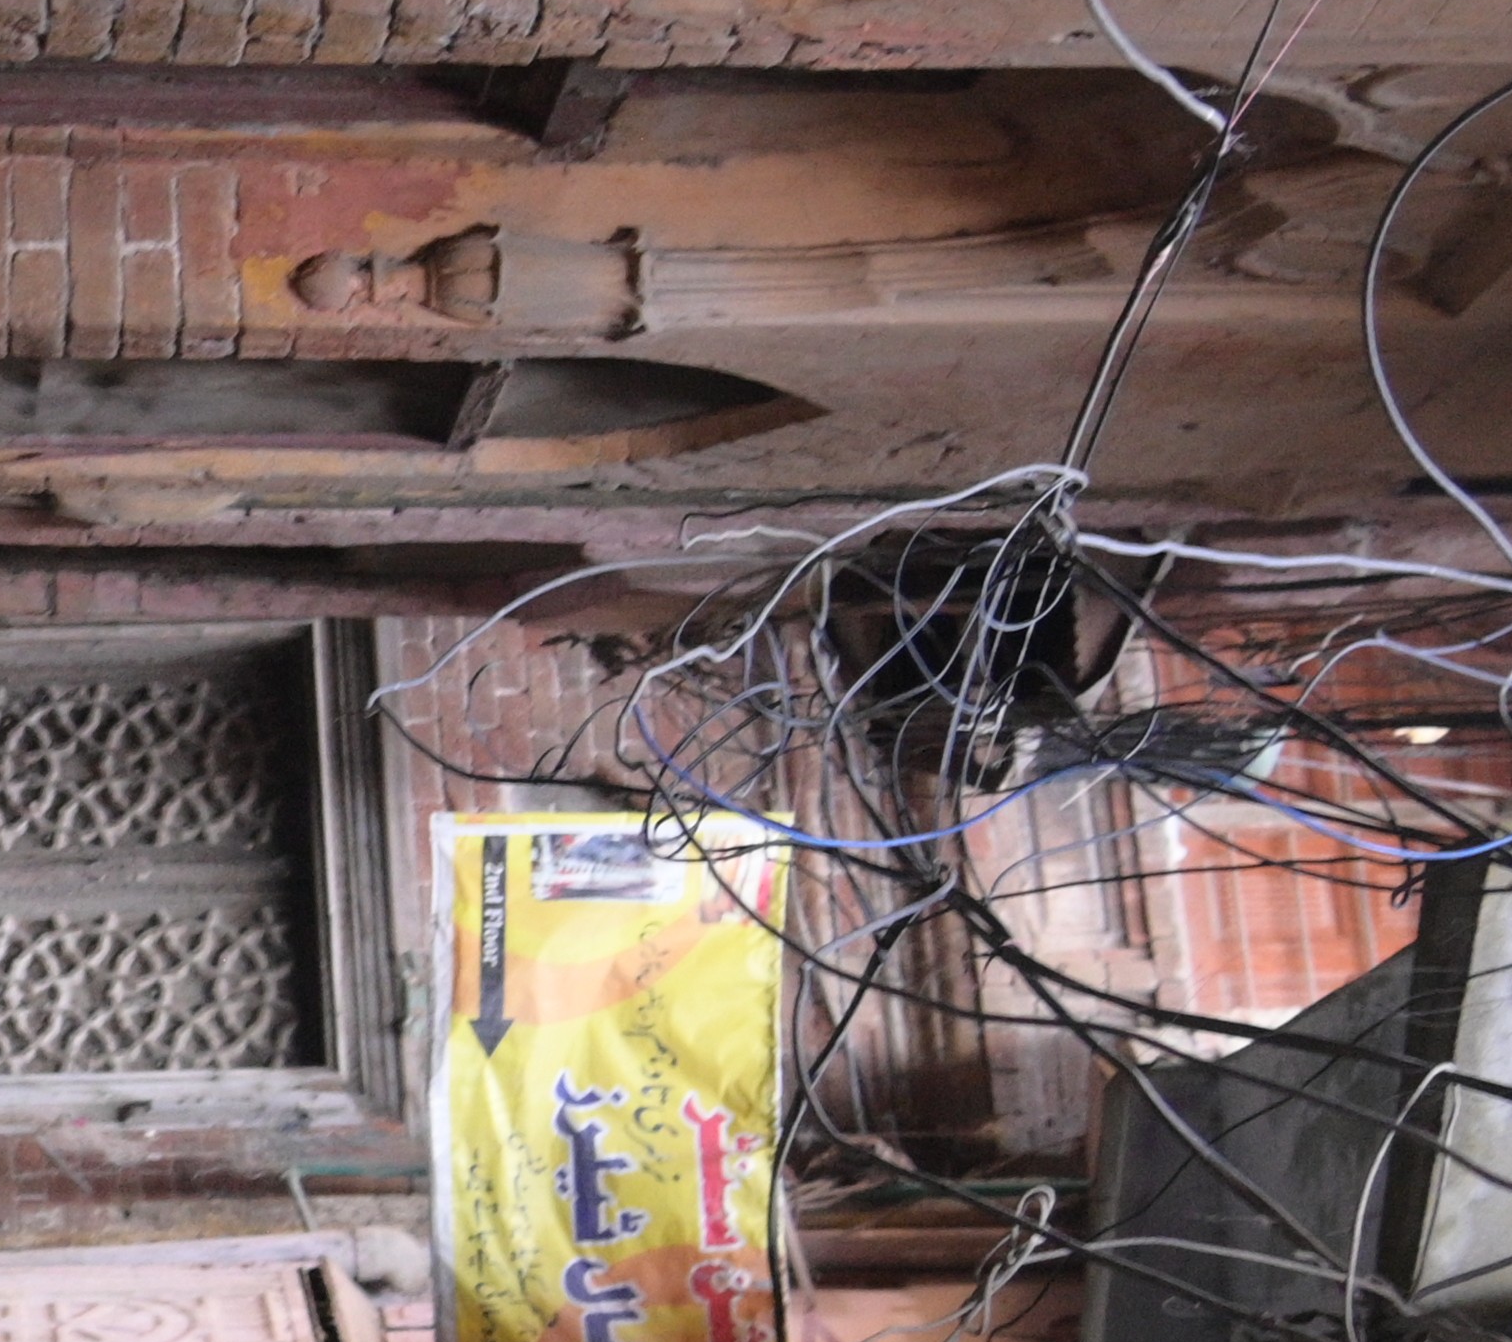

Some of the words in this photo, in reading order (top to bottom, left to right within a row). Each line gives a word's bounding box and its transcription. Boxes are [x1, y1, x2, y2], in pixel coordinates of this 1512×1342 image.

[484, 861, 505, 904] 2nd
[483, 908, 505, 968] Floor
[621, 1032, 680, 1079] دہم
[640, 1084, 674, 1106] تا
[554, 1070, 649, 1245] ٹیلرز
[623, 1106, 683, 1185] نرسری
[682, 1093, 766, 1249] سنٹر
